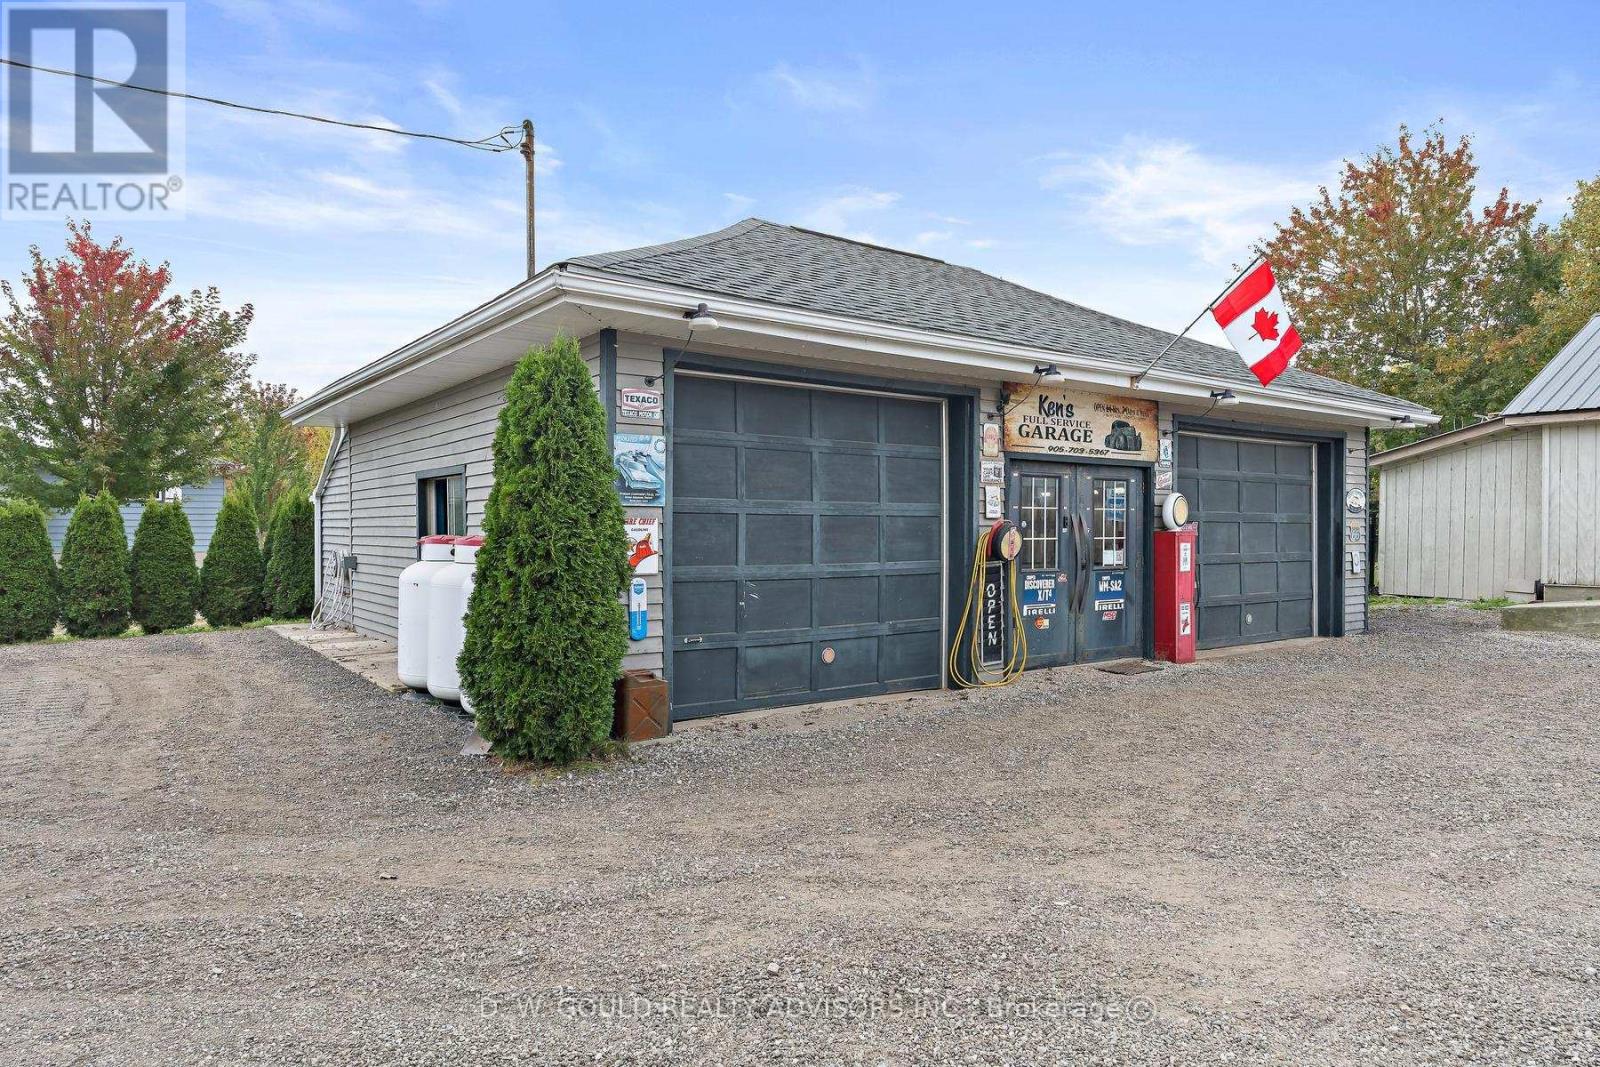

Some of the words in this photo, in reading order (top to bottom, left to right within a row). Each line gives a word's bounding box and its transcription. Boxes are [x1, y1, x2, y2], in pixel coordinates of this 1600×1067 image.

[625, 394, 658, 404] TEXACO
[1038, 394, 1075, 419] Ken's
[1023, 415, 1051, 425] FULL
[1051, 417, 1092, 429] SERVICE
[1018, 423, 1093, 443] GARAGE
[1022, 603, 1056, 617] PIRELLI
[1095, 598, 1125, 611] PIRELLI
[986, 583, 998, 646] OPEN
